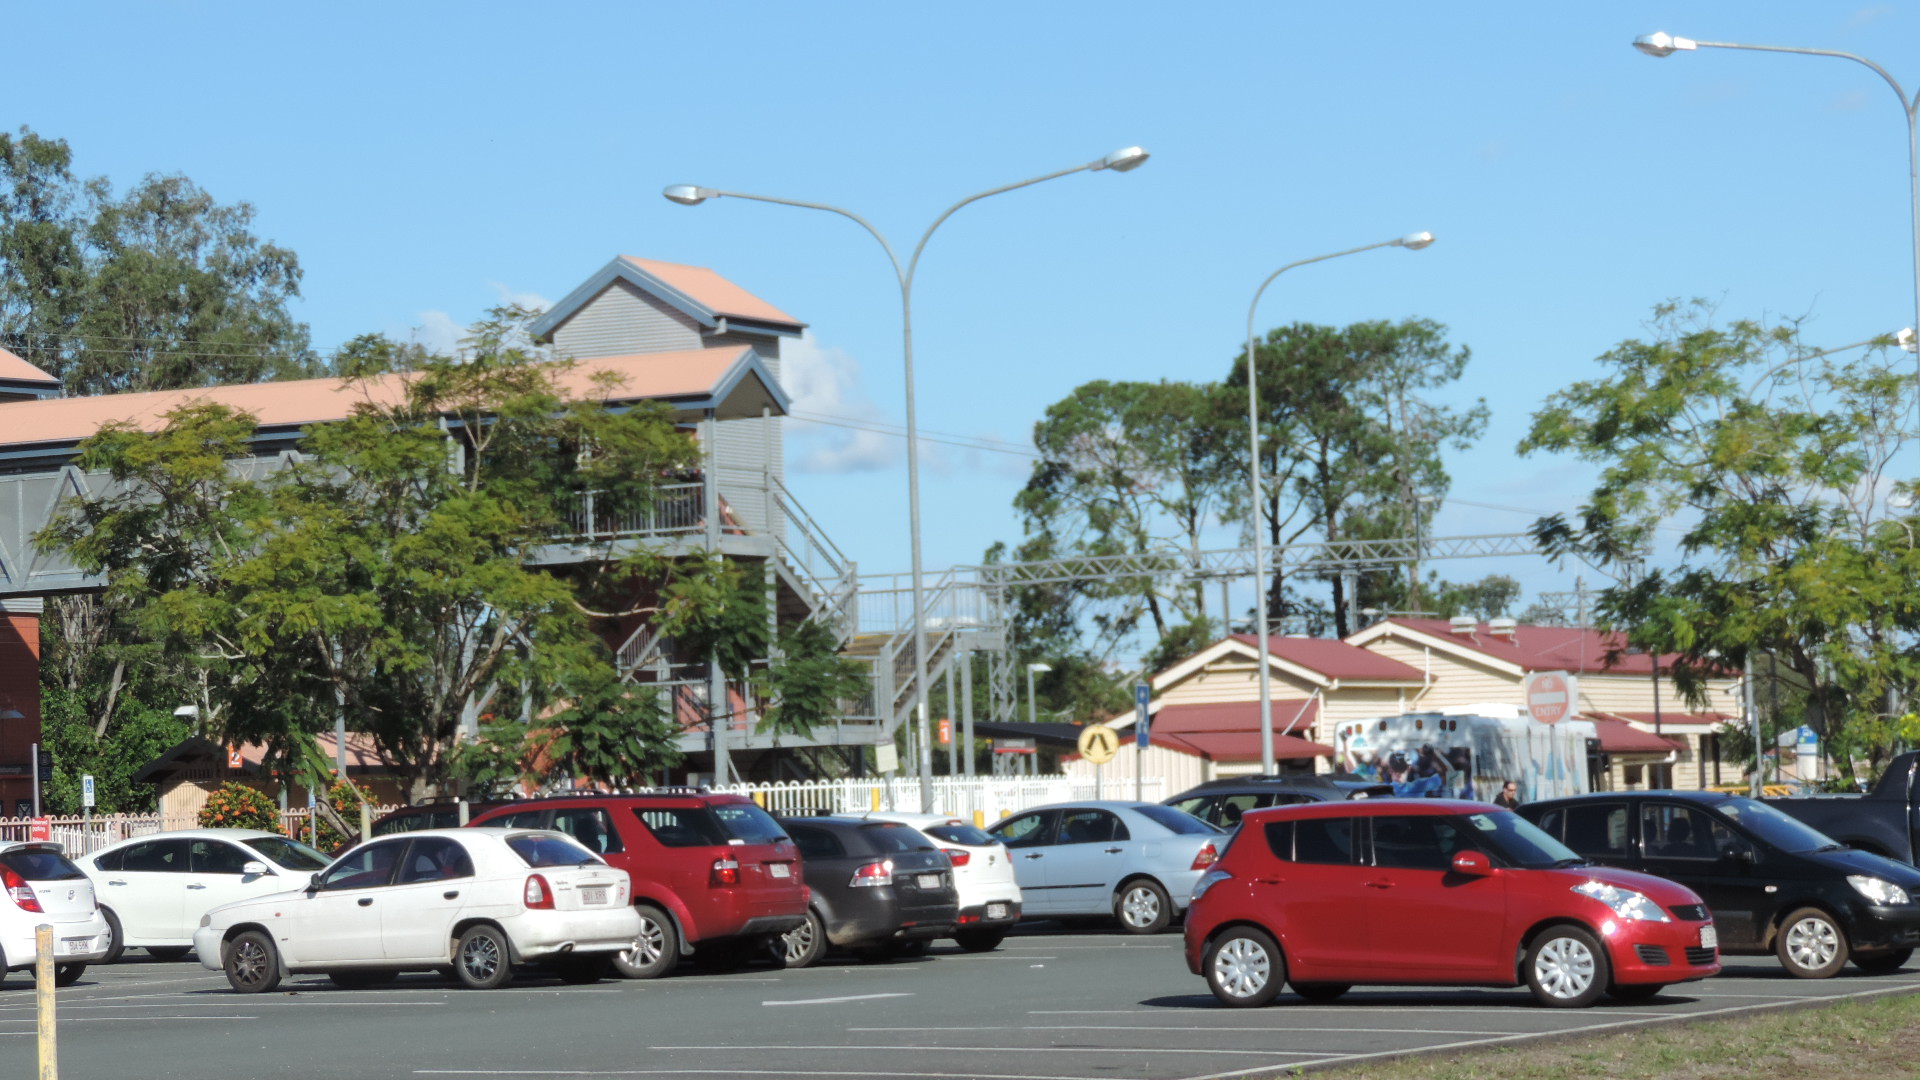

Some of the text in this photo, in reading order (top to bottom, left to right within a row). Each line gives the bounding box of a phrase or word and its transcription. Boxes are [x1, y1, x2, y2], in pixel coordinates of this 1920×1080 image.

[1541, 679, 1554, 689] NO
[1535, 705, 1561, 717] ENTRY
[941, 727, 949, 740] 1
[231, 751, 240, 765] 2
